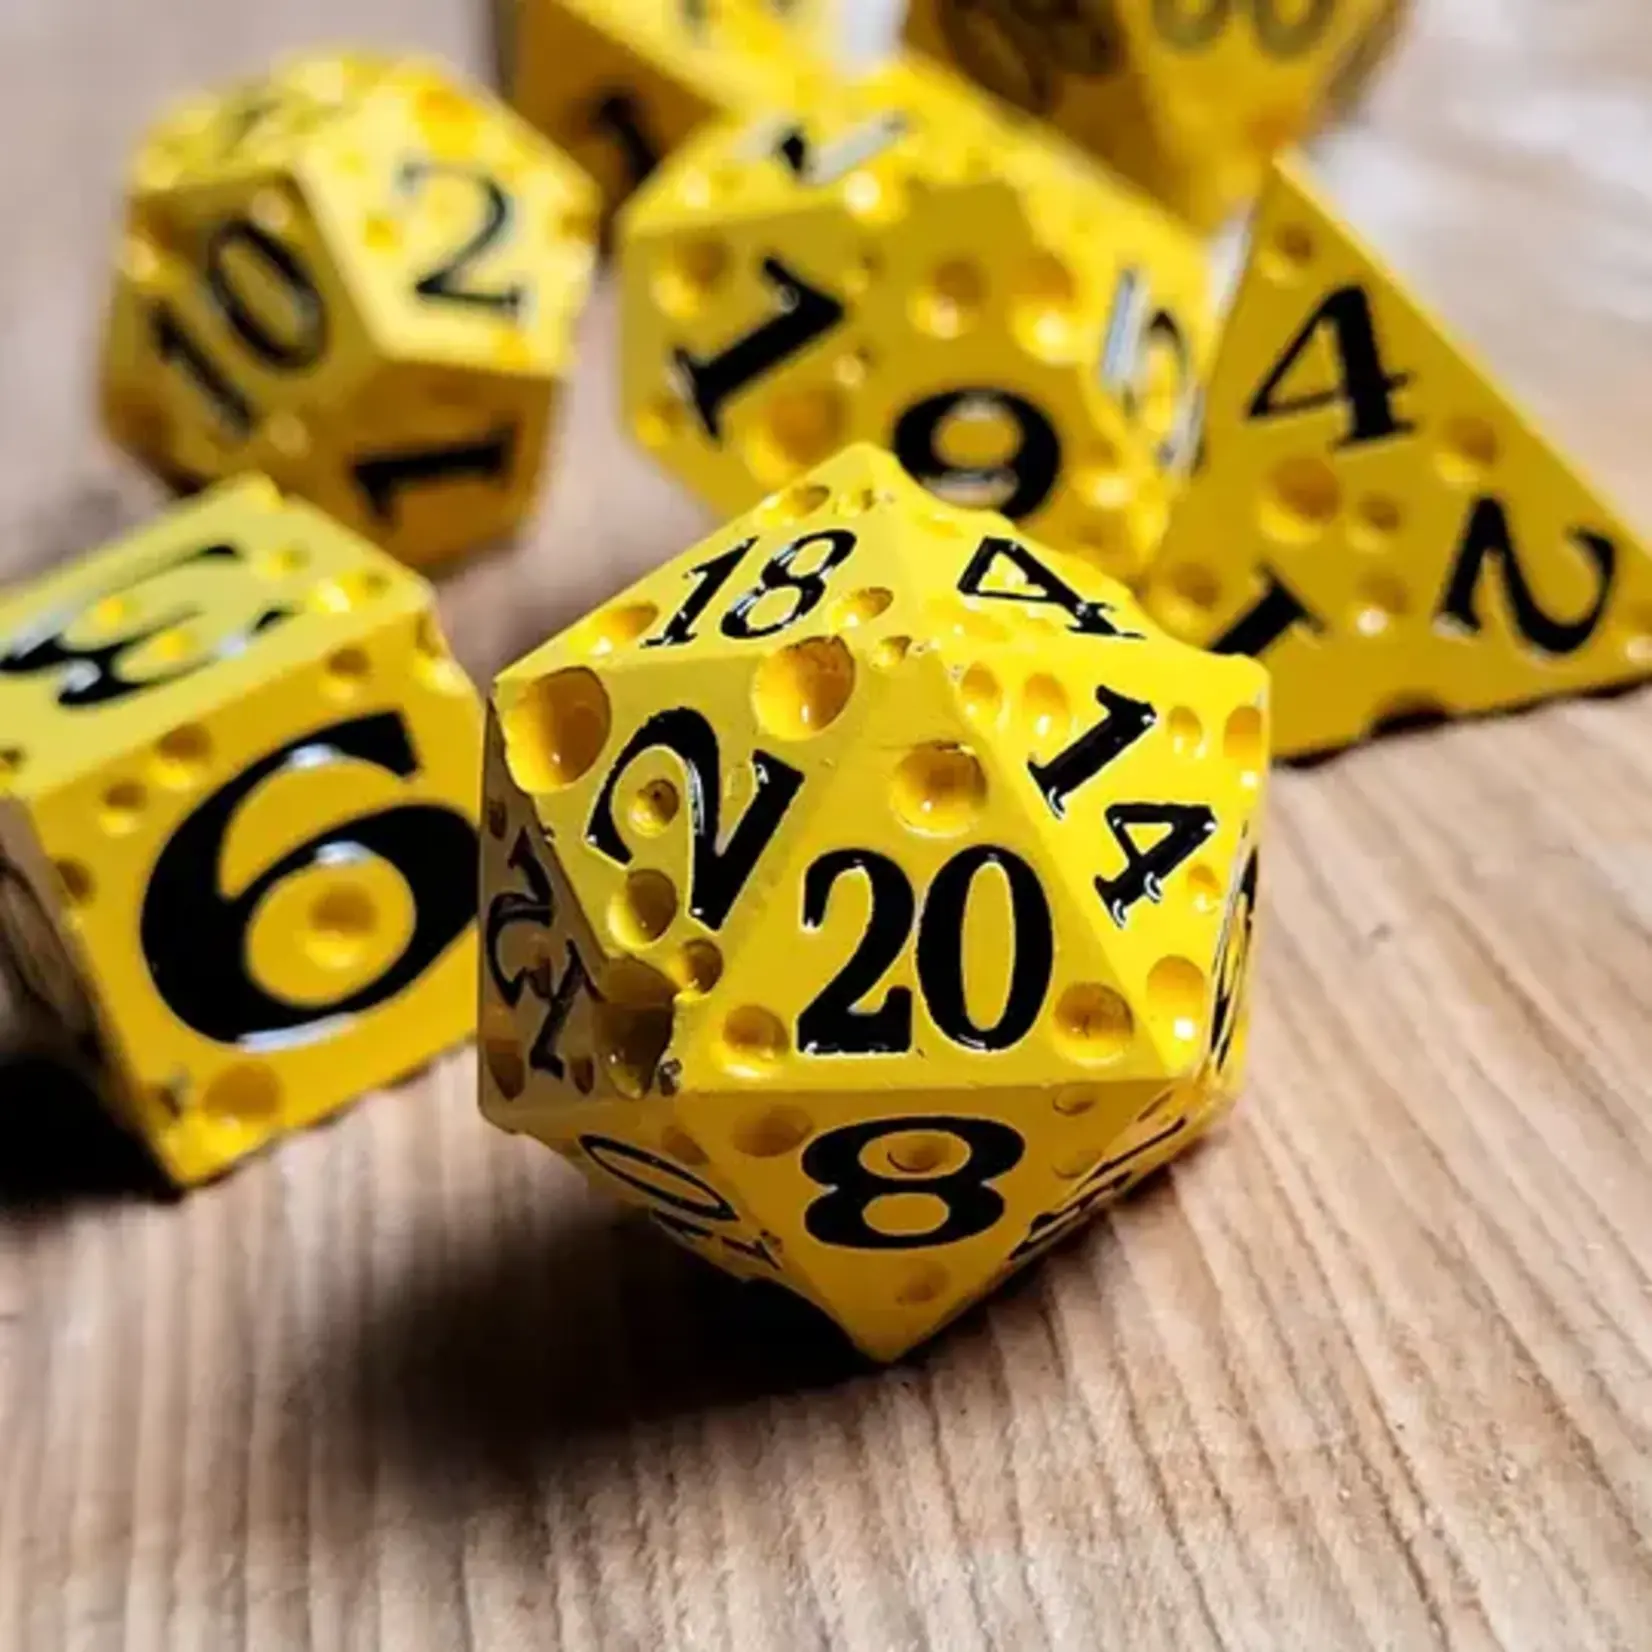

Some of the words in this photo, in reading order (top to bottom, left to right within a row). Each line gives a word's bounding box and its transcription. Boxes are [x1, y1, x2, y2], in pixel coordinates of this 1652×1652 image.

[396, 160, 524, 314] 2
[148, 218, 328, 440] 10
[669, 256, 848, 441] 1
[1247, 284, 1413, 450] 4
[350, 424, 516, 522] 1
[0, 543, 290, 706] 3
[641, 529, 857, 649] 18
[956, 536, 1143, 638] 4
[1434, 496, 1617, 654] 2
[140, 710, 480, 1052] 6
[585, 707, 804, 929] 2
[1026, 684, 1217, 929] 14
[797, 845, 1054, 1056] 20
[800, 1116, 1025, 1249] 8
